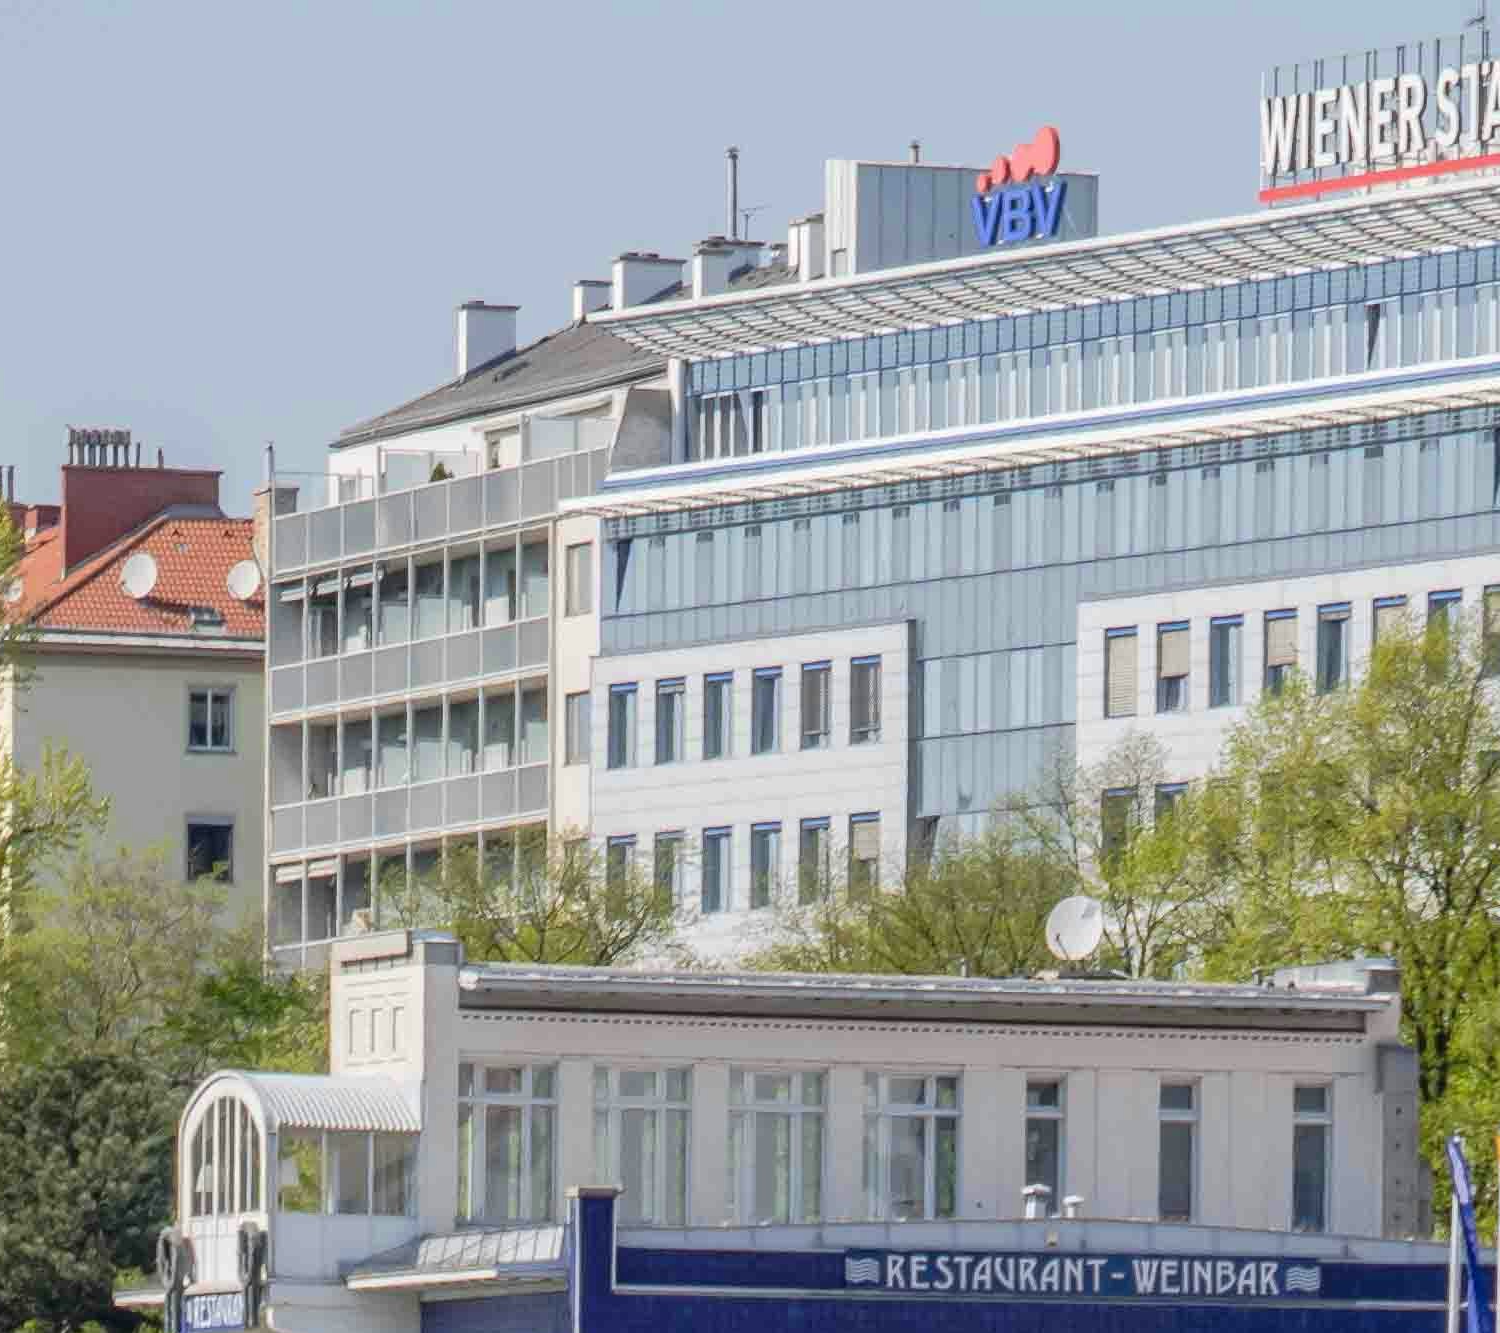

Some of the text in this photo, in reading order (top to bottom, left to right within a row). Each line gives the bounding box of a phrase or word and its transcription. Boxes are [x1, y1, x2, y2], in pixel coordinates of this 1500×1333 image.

[1259, 72, 1428, 177] WIENER
[971, 181, 1067, 249] VBV
[887, 1254, 1109, 1293] RESTAURANT
[1132, 1259, 1281, 1297] WEINBAR
